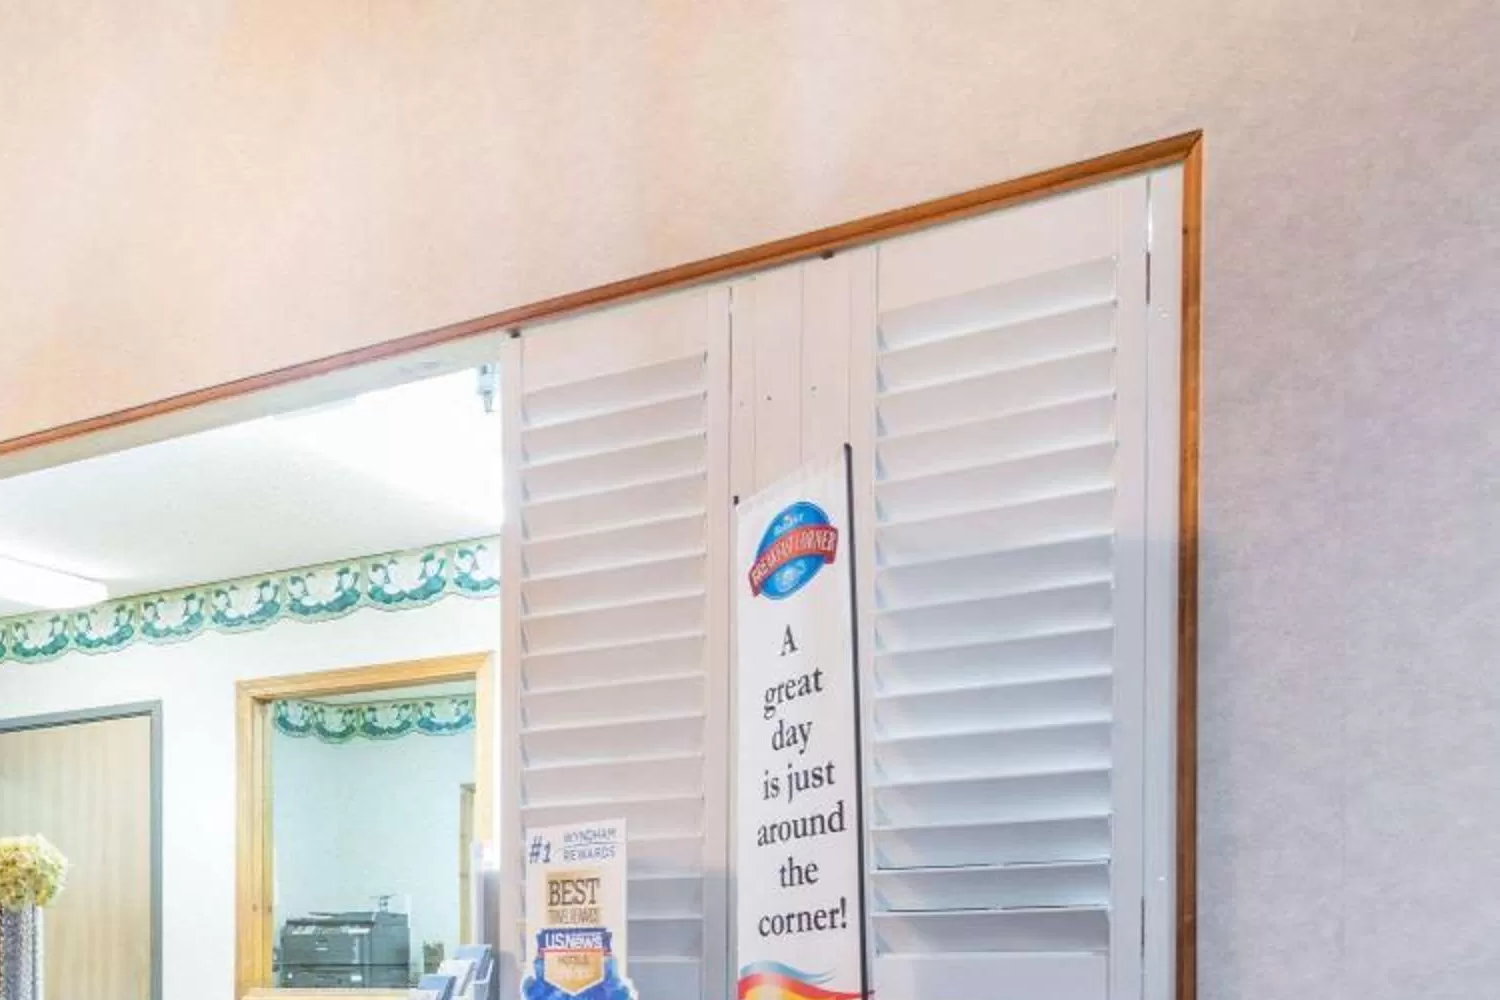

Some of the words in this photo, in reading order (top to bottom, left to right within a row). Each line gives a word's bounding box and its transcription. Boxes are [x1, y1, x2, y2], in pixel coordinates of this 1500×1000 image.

[779, 624, 800, 656] A
[763, 667, 824, 721] great
[771, 719, 813, 756] day
[762, 769, 781, 801] is
[786, 760, 837, 803] just
[756, 800, 847, 848] around
[547, 876, 600, 907] BEST
[779, 856, 820, 890] the
[757, 896, 848, 938] corner!
